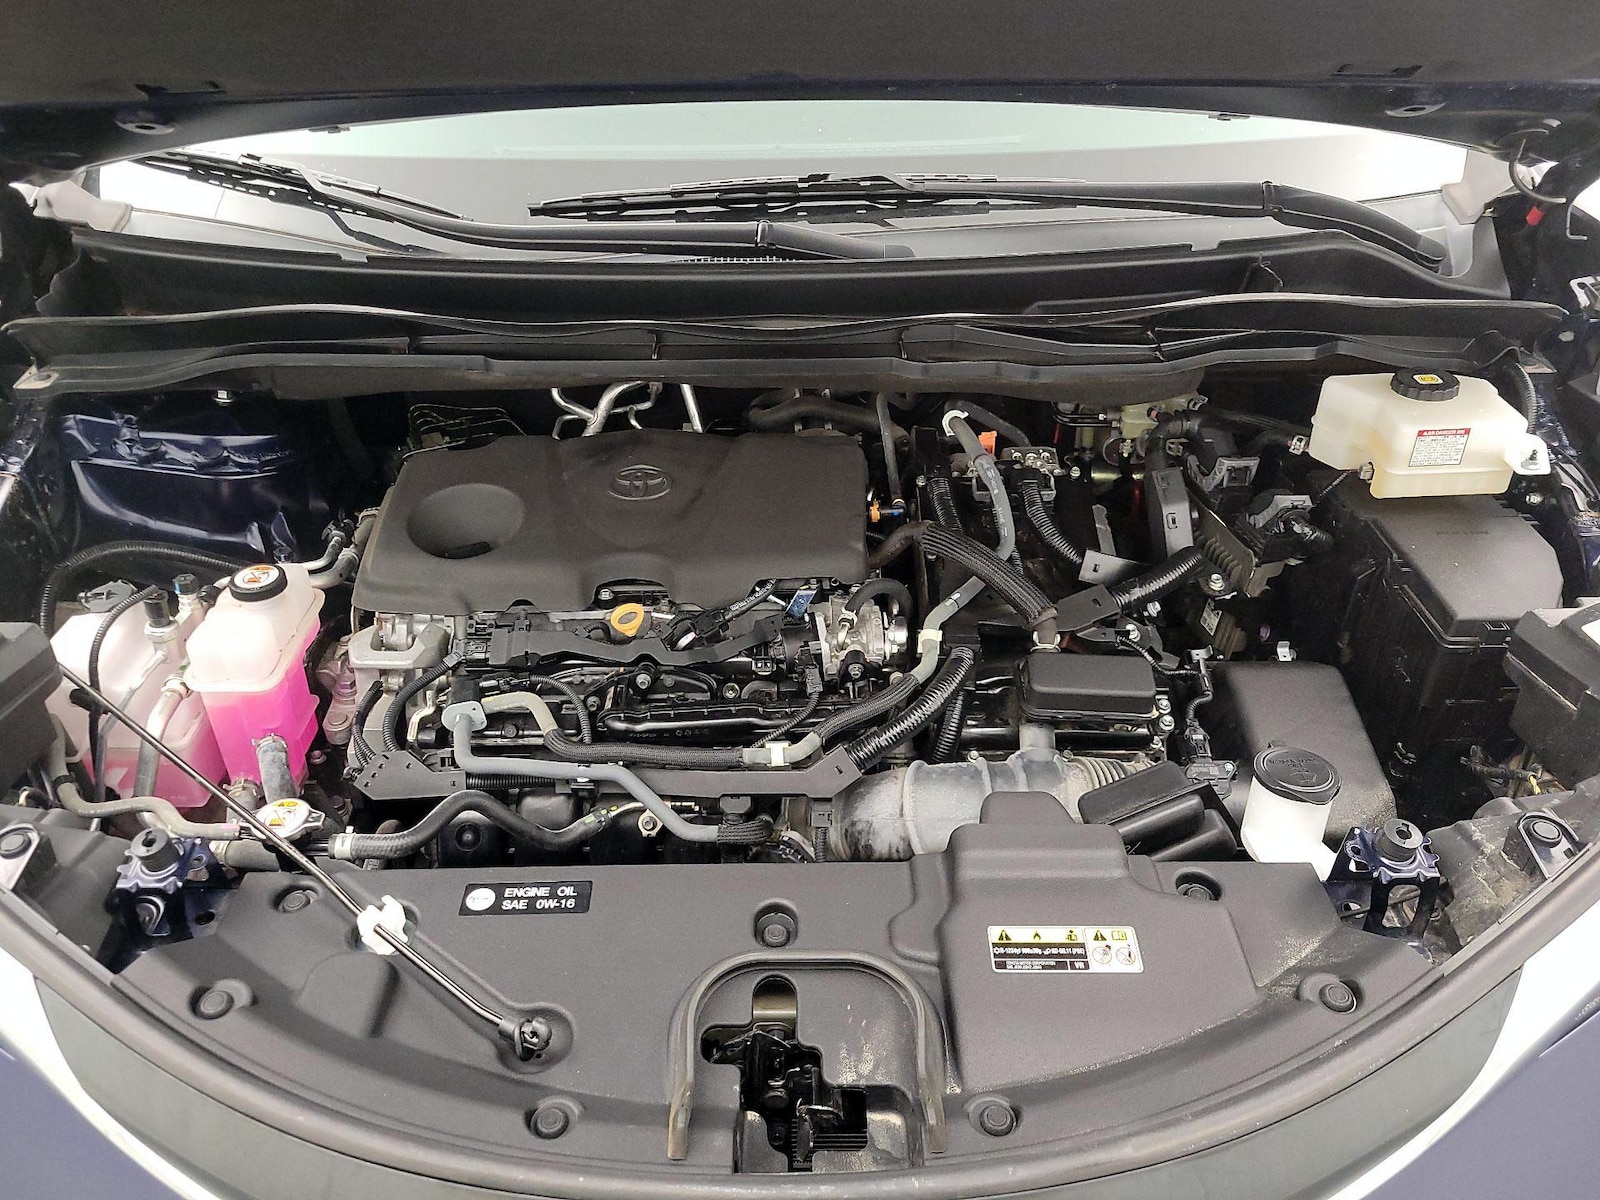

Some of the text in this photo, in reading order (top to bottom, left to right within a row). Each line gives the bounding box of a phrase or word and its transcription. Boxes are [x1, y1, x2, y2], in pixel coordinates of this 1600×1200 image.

[504, 886, 578, 898] ENGINE OIL
[501, 899, 576, 910] SAE 0W-16
